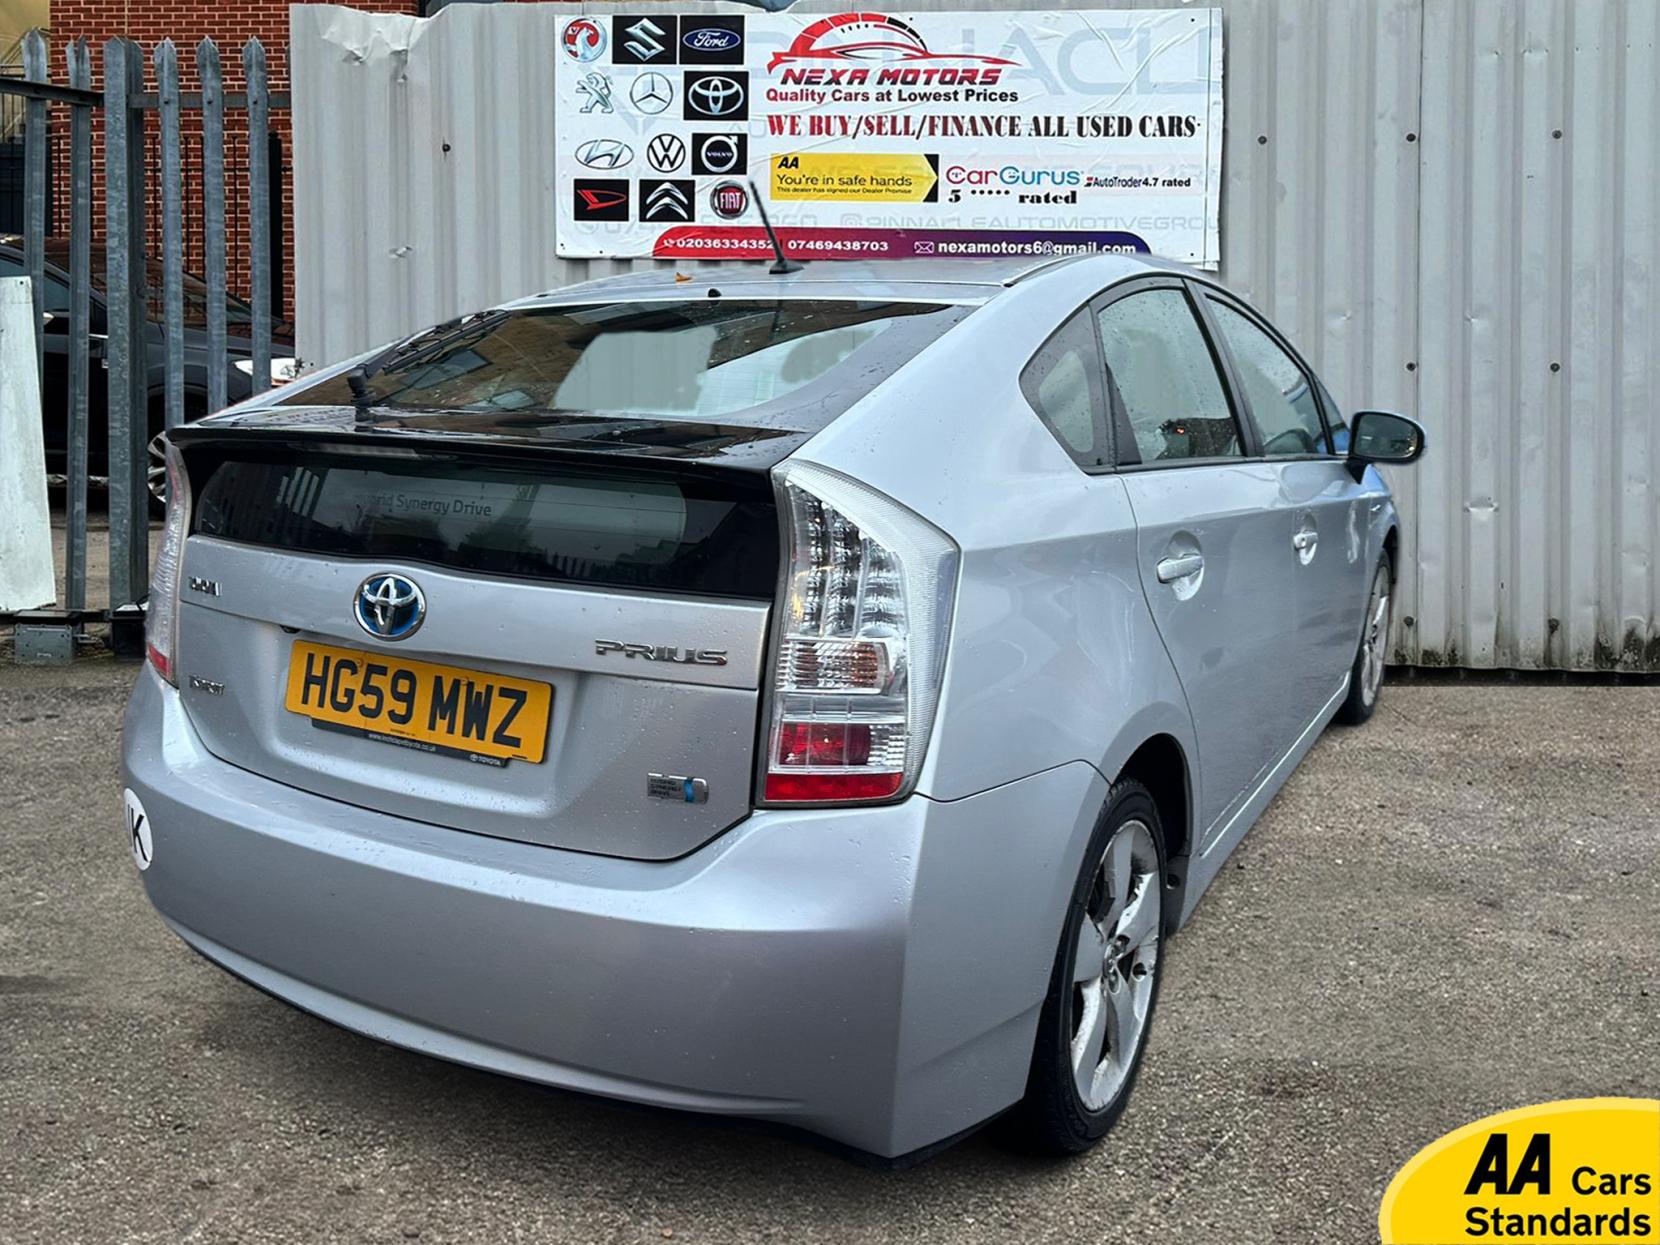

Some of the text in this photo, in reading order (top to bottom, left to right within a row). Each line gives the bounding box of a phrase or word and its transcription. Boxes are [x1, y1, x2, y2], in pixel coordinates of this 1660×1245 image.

[694, 31, 729, 46] Ford
[781, 68, 1002, 85] NEXA MOTORS
[766, 88, 1019, 104] Quality Cars at Lowest Prices
[767, 115, 802, 136] WE
[809, 115, 1021, 139] BUY/SELL/FINANCE
[1028, 116, 1069, 137] ALL
[1076, 116, 1132, 137] USED
[1139, 116, 1196, 137] CARS
[778, 156, 799, 169] AA
[776, 174, 912, 187] You're in safe hands
[946, 165, 1080, 185] CarGurus
[1162, 178, 1191, 187] rated
[720, 192, 741, 209] FIAT
[949, 189, 1077, 204] 5 rated
[676, 238, 888, 251] 02036334352 07469438703
[938, 240, 1136, 255] nexamotors6@gmail.com
[395, 494, 449, 515] Synergy
[453, 499, 492, 516] Drive
[594, 639, 728, 665] PRIUS
[301, 652, 528, 748] HG59 MWZ
